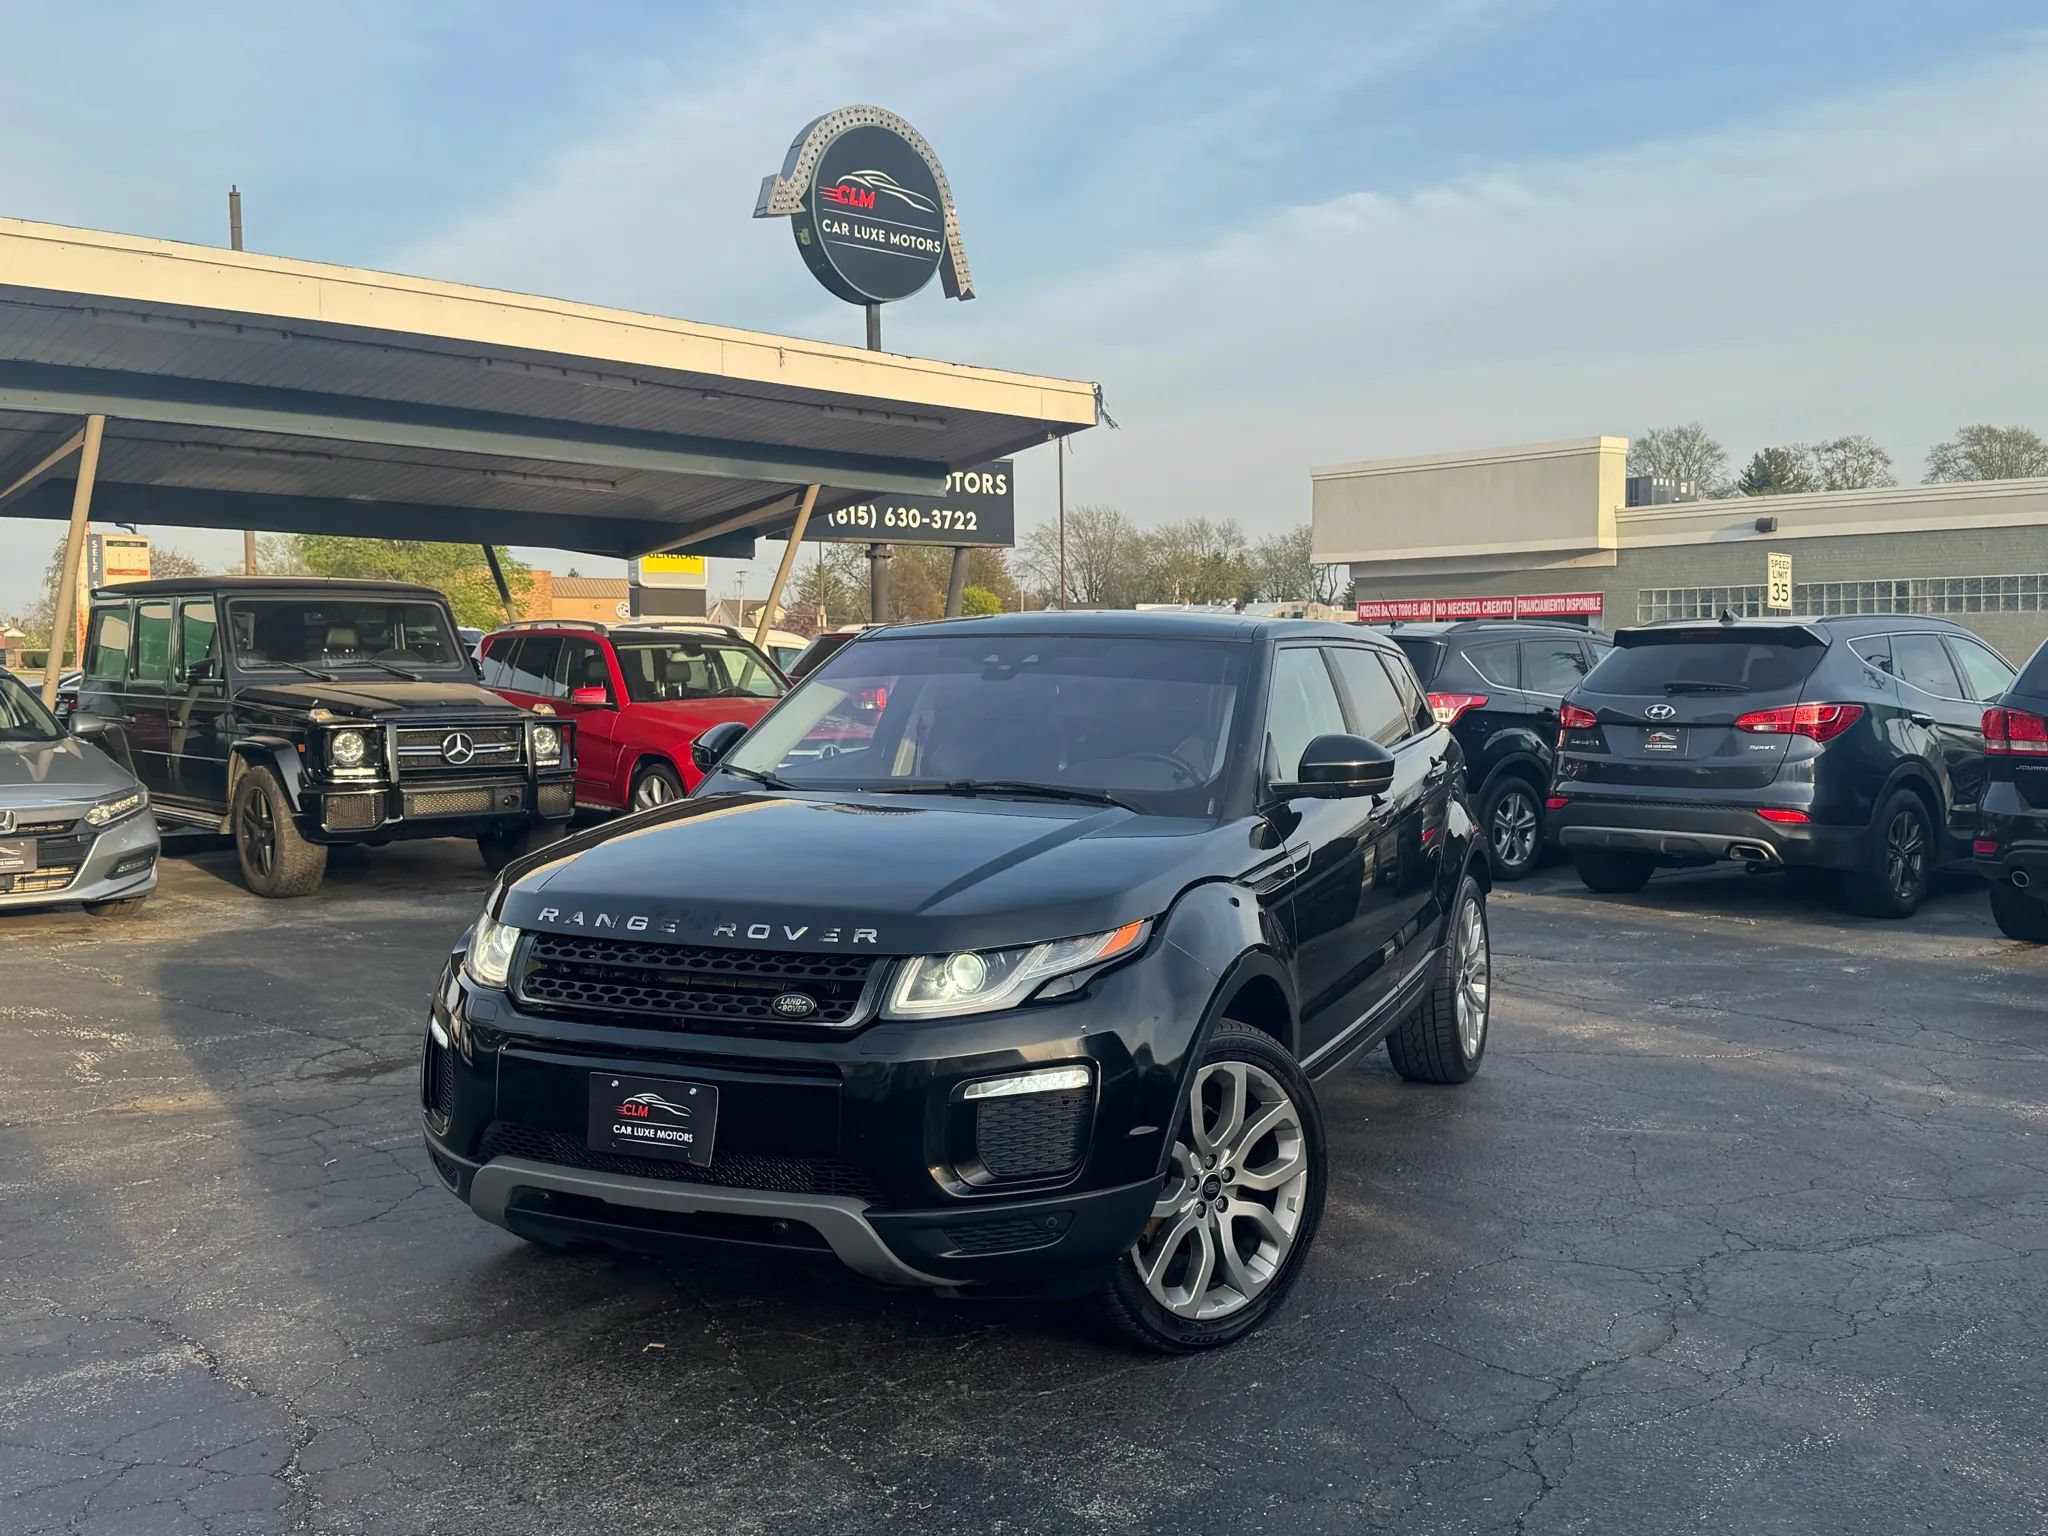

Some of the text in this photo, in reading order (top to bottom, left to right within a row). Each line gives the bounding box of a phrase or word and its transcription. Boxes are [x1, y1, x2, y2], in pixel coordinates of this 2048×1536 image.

[836, 184, 876, 209] CLM
[822, 219, 941, 253] CAR LUXE MOTORS
[828, 504, 978, 531] (815) 630-3722
[91, 540, 99, 573] SELF
[1771, 559, 1790, 570] SPEED
[1772, 570, 1788, 580] LIMIT
[1772, 583, 1789, 602] 35
[1359, 604, 1381, 617] PRECIOS
[1398, 603, 1412, 616] TODO
[1413, 603, 1419, 616] EL
[1419, 602, 1431, 616] AÑO
[1436, 600, 1512, 616] NO NECESITA CREDITO
[1517, 597, 1601, 612] FINANCIAMIENTO DISPONIBLE
[537, 907, 879, 944] RANGE ROVER
[623, 1104, 649, 1118] CLM
[613, 1124, 694, 1143] CAR LUXE MOTORS
